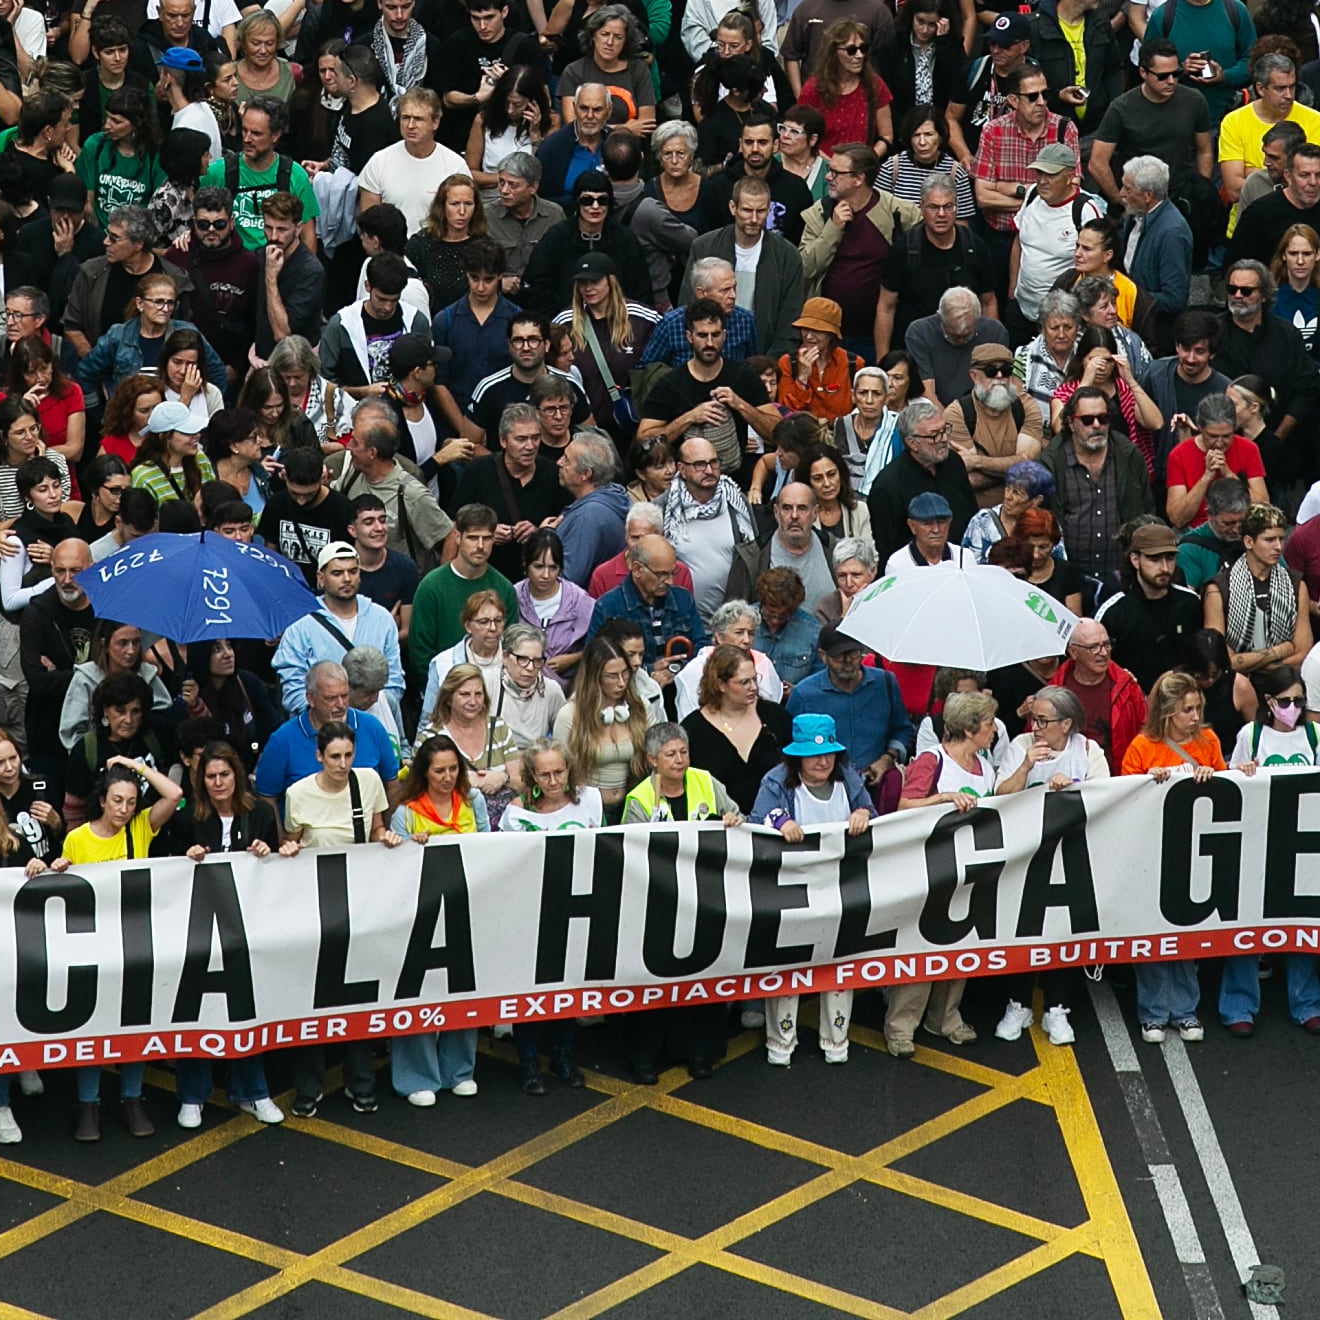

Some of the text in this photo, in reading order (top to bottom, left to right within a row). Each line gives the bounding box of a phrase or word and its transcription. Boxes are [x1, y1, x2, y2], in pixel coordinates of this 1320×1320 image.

[99, 174, 146, 193] UNIVERSIDAD
[99, 548, 164, 583] 7291
[202, 567, 233, 626] 7291
[313, 843, 477, 1009] LA
[535, 789, 1100, 985] HUELGA
[43, 1039, 122, 1065] DEL
[142, 1017, 347, 1058] ALQUILER
[368, 1006, 445, 1033] 50%
[500, 968, 813, 1019] EXPROPIACIÓN
[836, 950, 1007, 984] FONDOS
[1030, 937, 1178, 966] BUITRE
